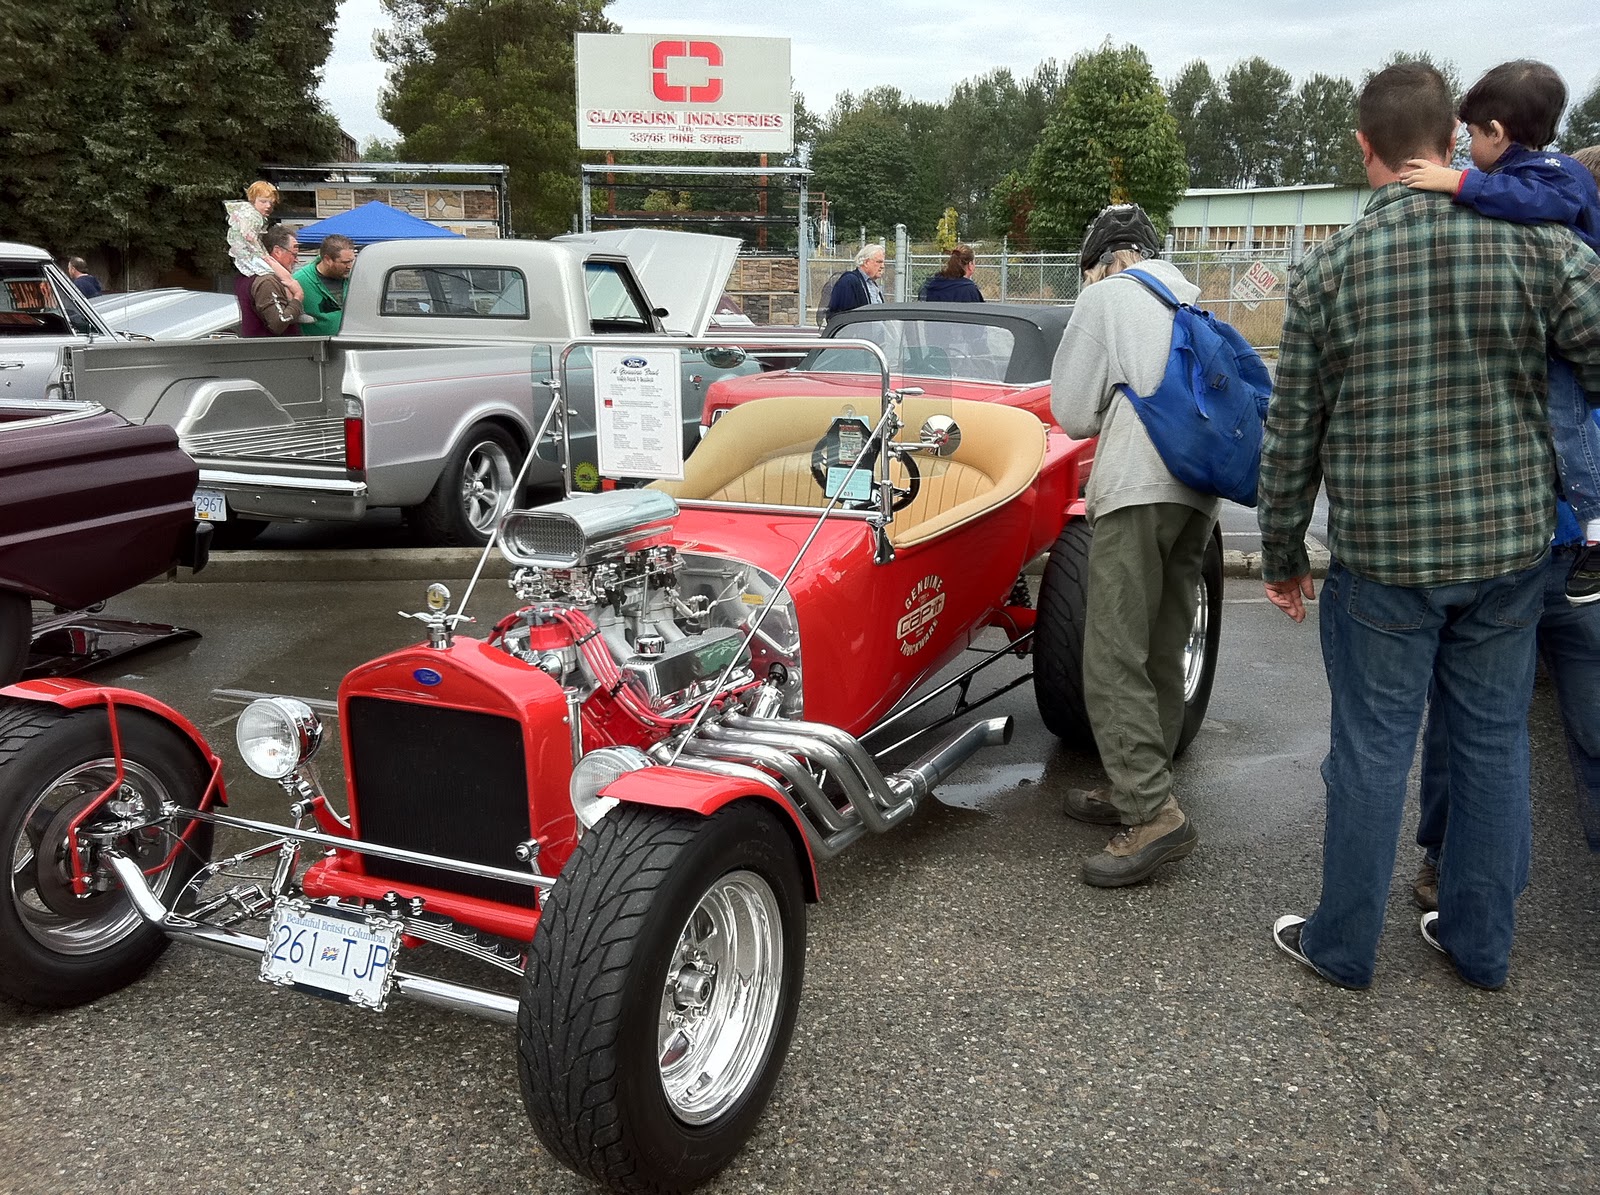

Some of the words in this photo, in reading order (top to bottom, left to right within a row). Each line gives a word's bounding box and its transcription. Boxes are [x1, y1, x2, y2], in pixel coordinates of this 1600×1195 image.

[586, 109, 678, 126] CLAYBURN
[683, 111, 784, 128] INDUSTRIES
[668, 133, 697, 144] PINE
[699, 134, 744, 145] STREET
[1249, 263, 1277, 290] SLOW
[196, 497, 223, 513] 2967
[905, 575, 943, 610] GENUINE
[286, 913, 320, 929] Beautiful
[321, 920, 347, 936] British
[272, 925, 318, 967] 261
[342, 937, 389, 981] TJP
